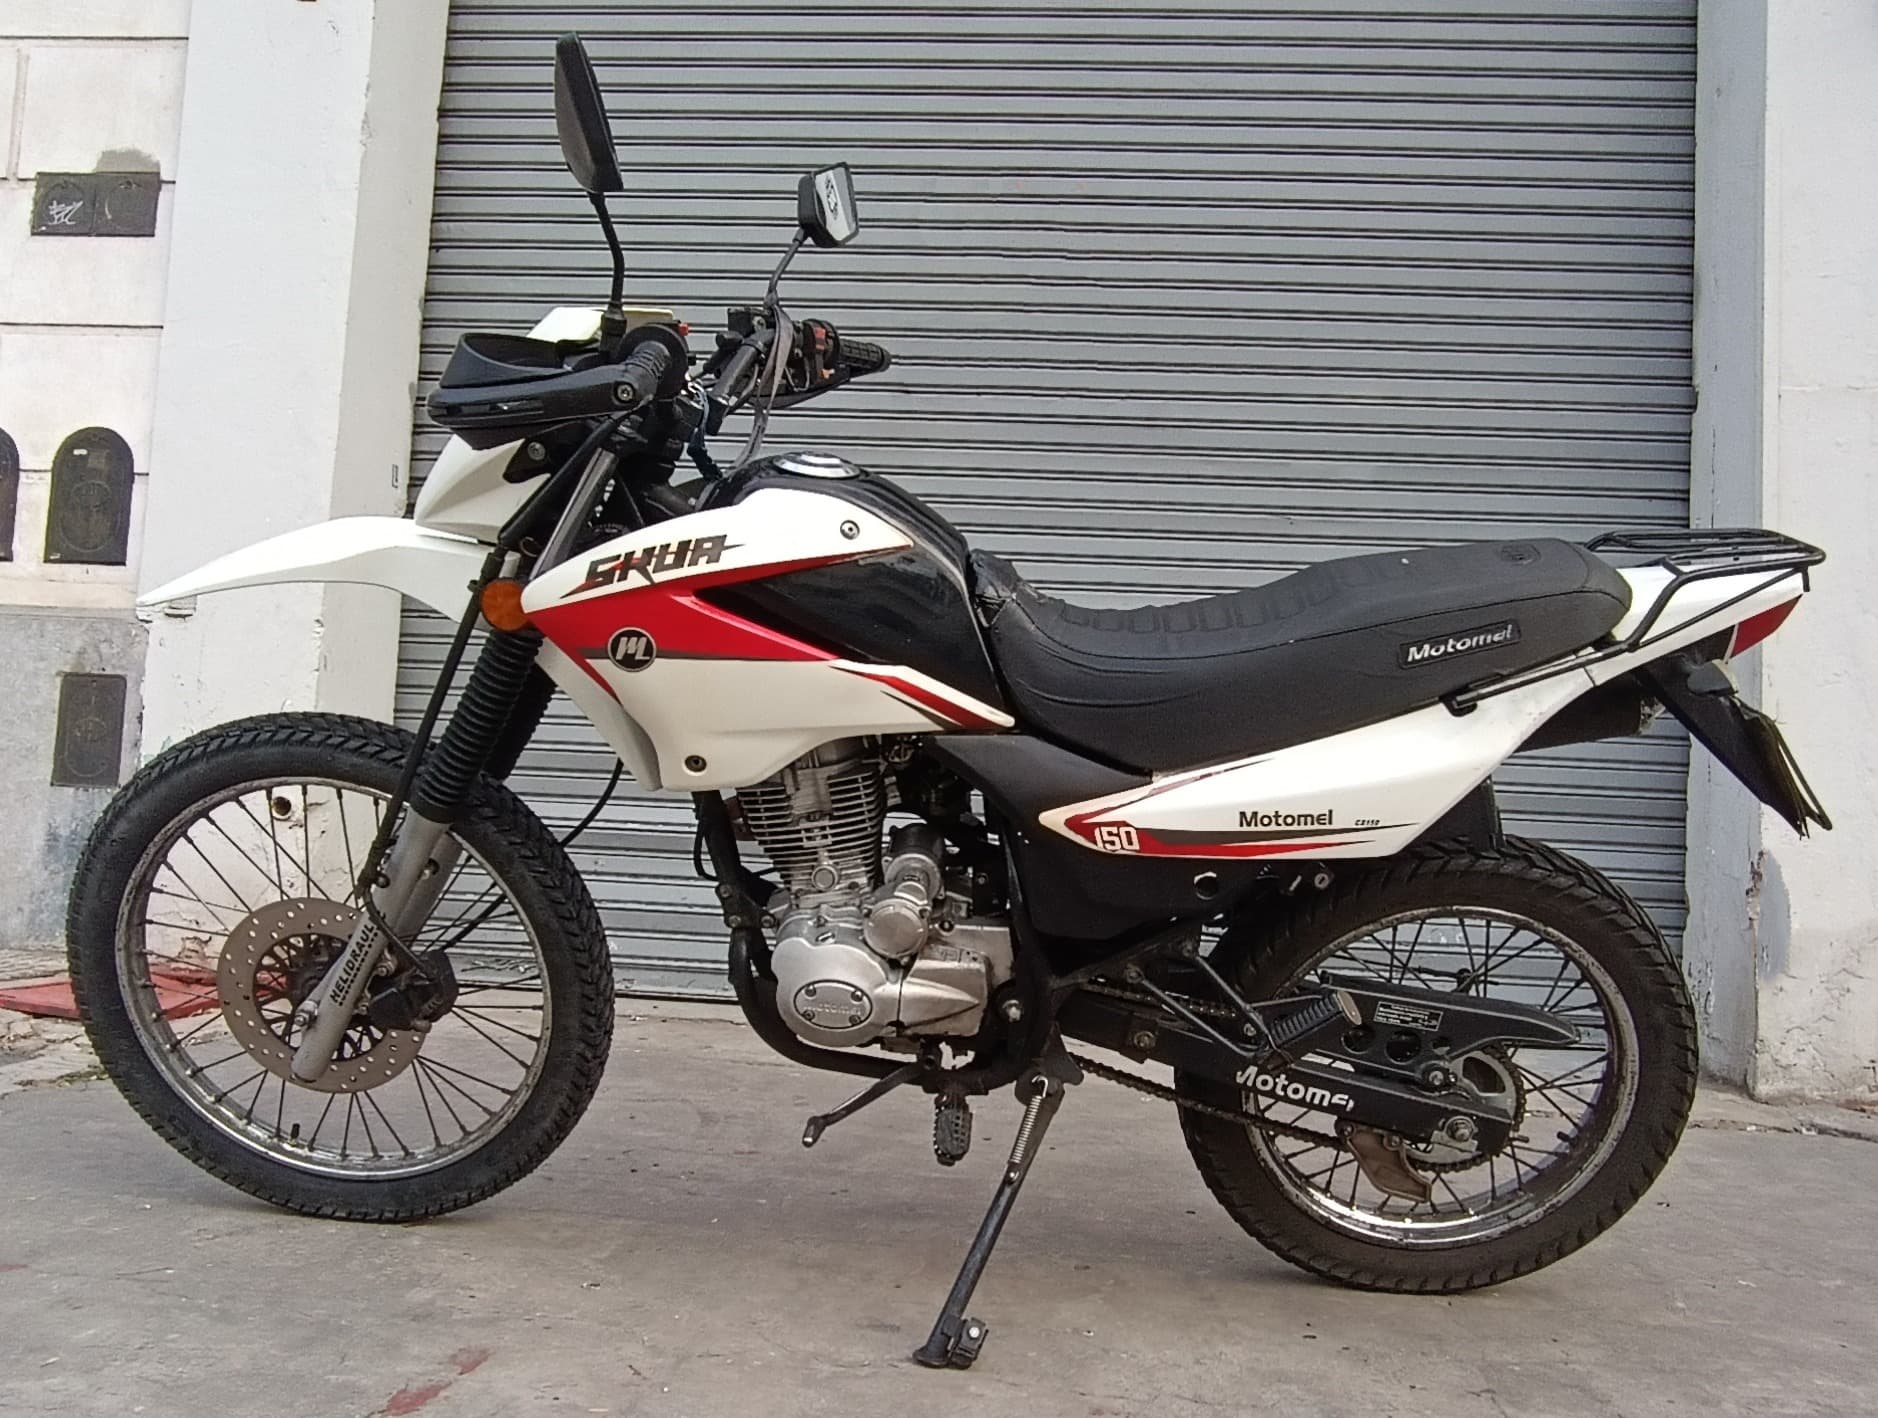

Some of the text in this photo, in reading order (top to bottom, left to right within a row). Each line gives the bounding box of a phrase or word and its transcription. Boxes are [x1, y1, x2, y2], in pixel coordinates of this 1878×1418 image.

[1407, 624, 1513, 662] Motomel
[1239, 809, 1333, 828] Motomel
[1094, 826, 1140, 850] 150
